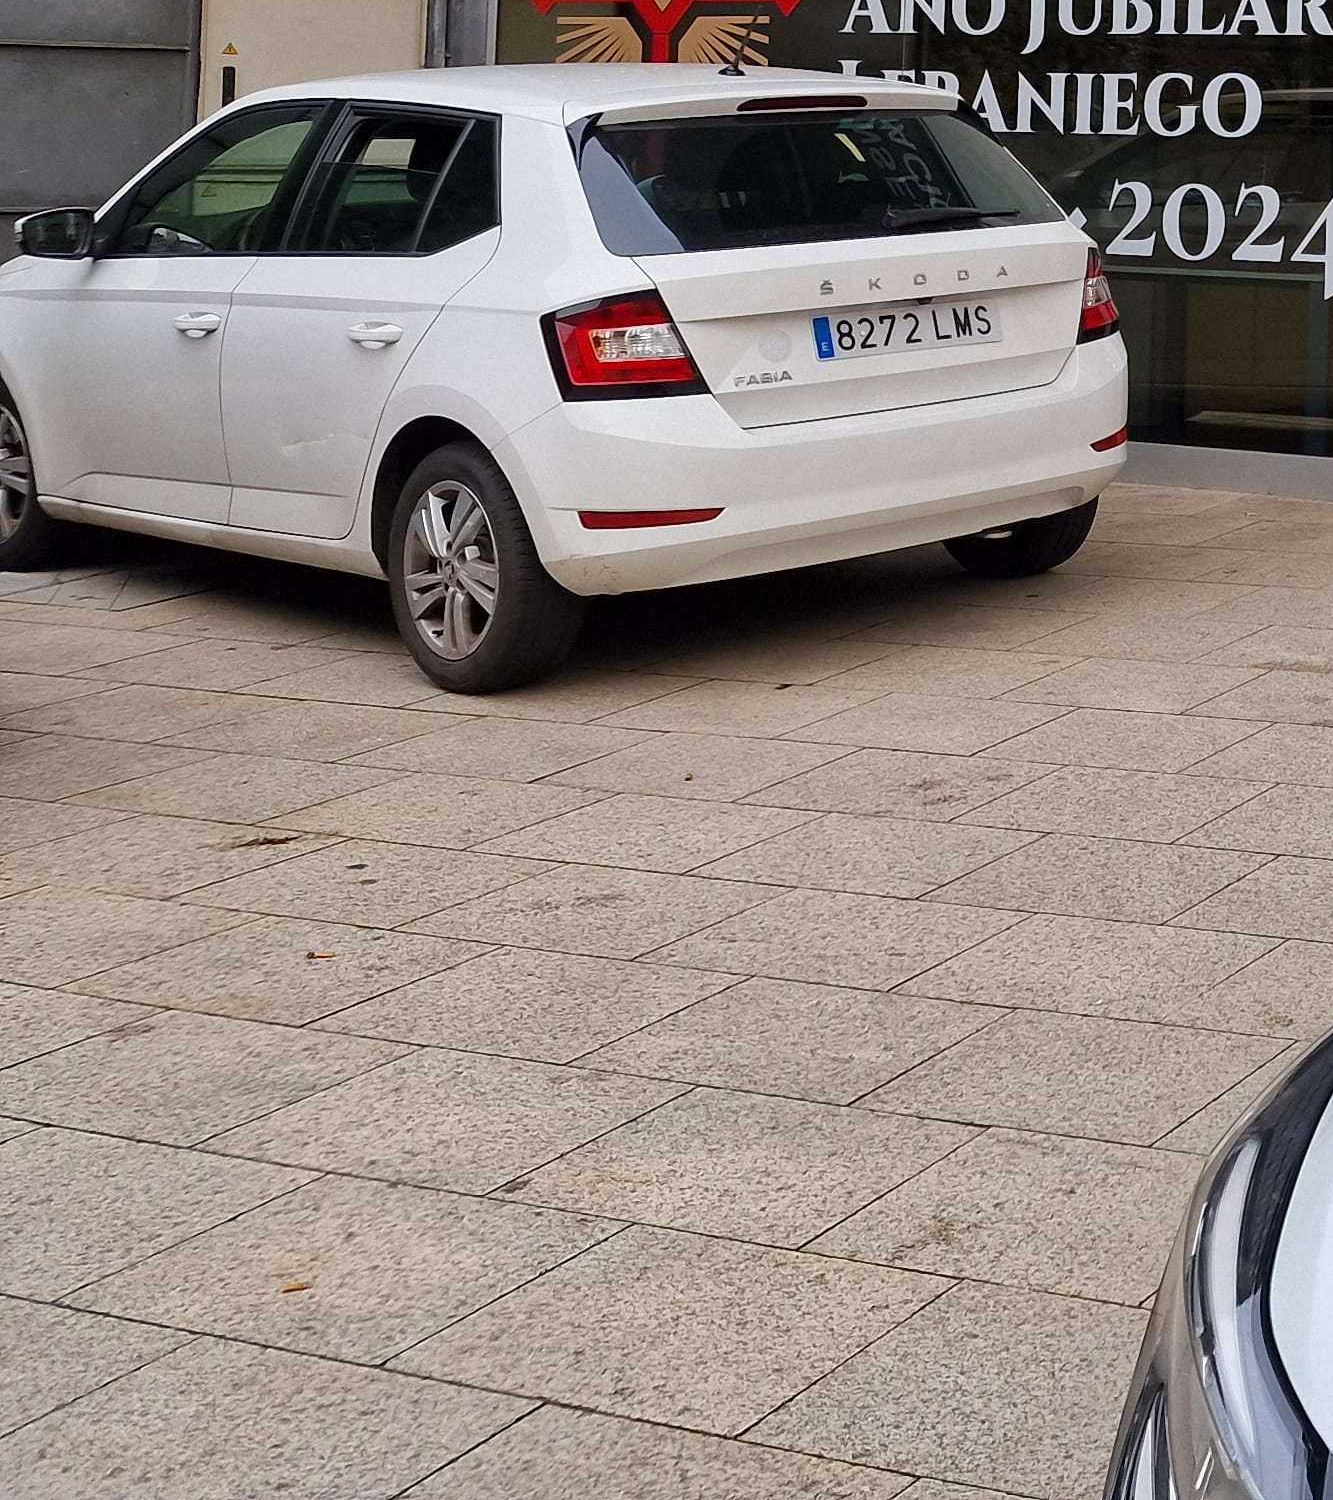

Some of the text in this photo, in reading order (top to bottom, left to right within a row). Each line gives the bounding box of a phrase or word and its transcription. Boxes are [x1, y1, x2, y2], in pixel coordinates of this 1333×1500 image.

[836, 59, 1264, 138] ANIEGO
[836, 312, 922, 351] 8272
[932, 305, 992, 342] LMS
[734, 370, 793, 387] FABIA
